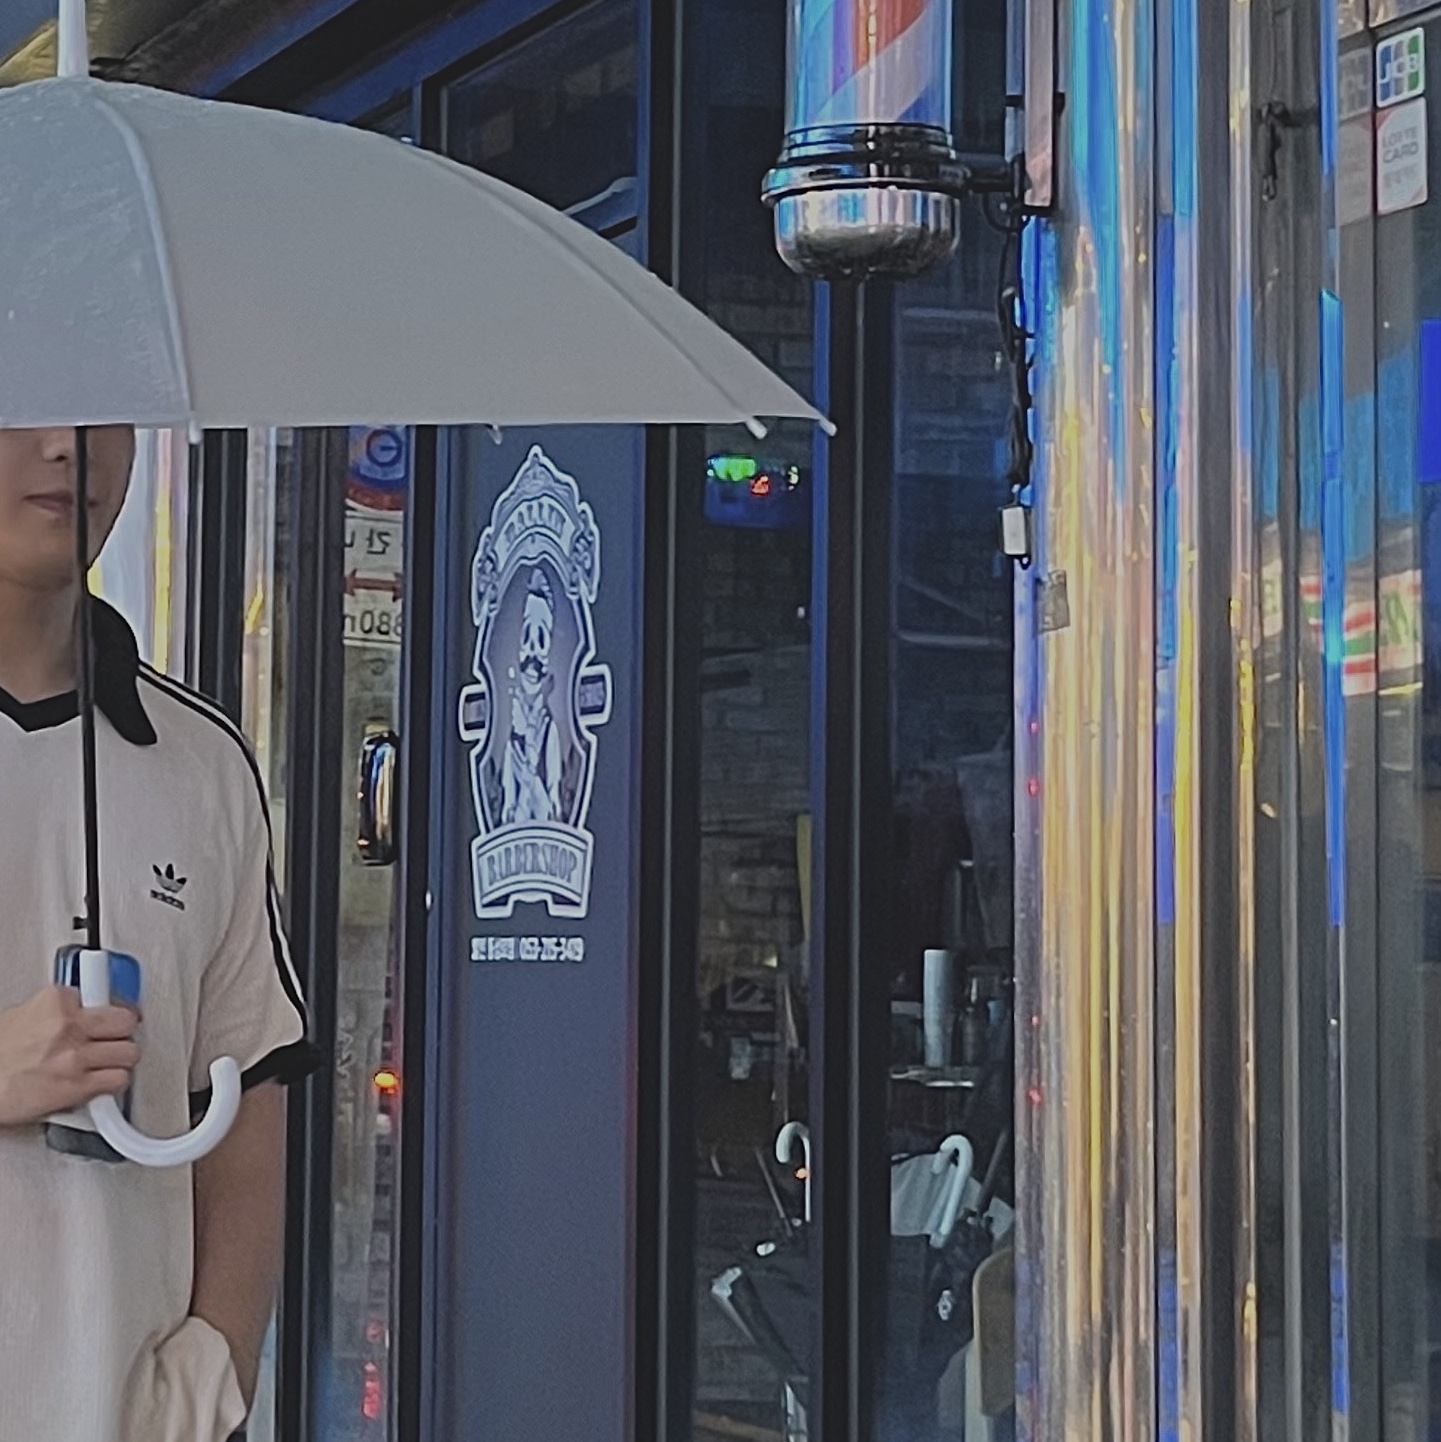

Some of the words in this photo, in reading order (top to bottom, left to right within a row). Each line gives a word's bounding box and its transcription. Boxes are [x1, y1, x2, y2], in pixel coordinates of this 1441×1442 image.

[1378, 53, 1421, 84] JCB
[1382, 141, 1419, 164] CARD
[486, 842, 578, 887] BARBERSHOP
